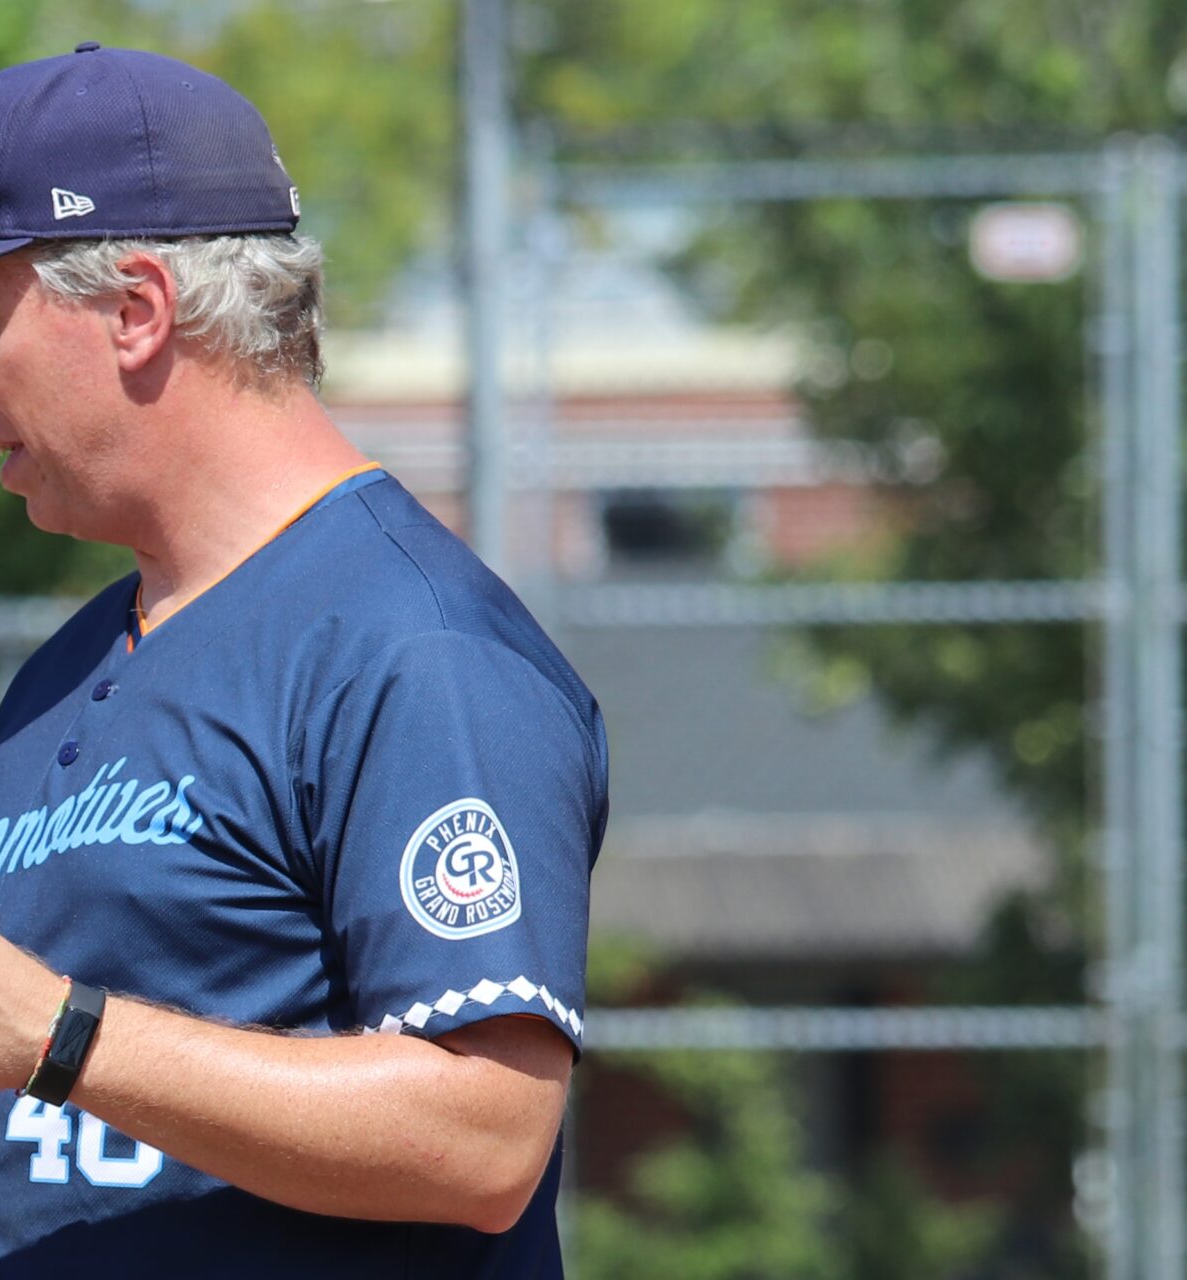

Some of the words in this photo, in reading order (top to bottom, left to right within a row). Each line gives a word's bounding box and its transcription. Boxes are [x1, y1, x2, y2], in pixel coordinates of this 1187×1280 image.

[425, 811, 496, 852] PHENIX
[445, 841, 496, 887] GR
[414, 875, 460, 925] GRAND
